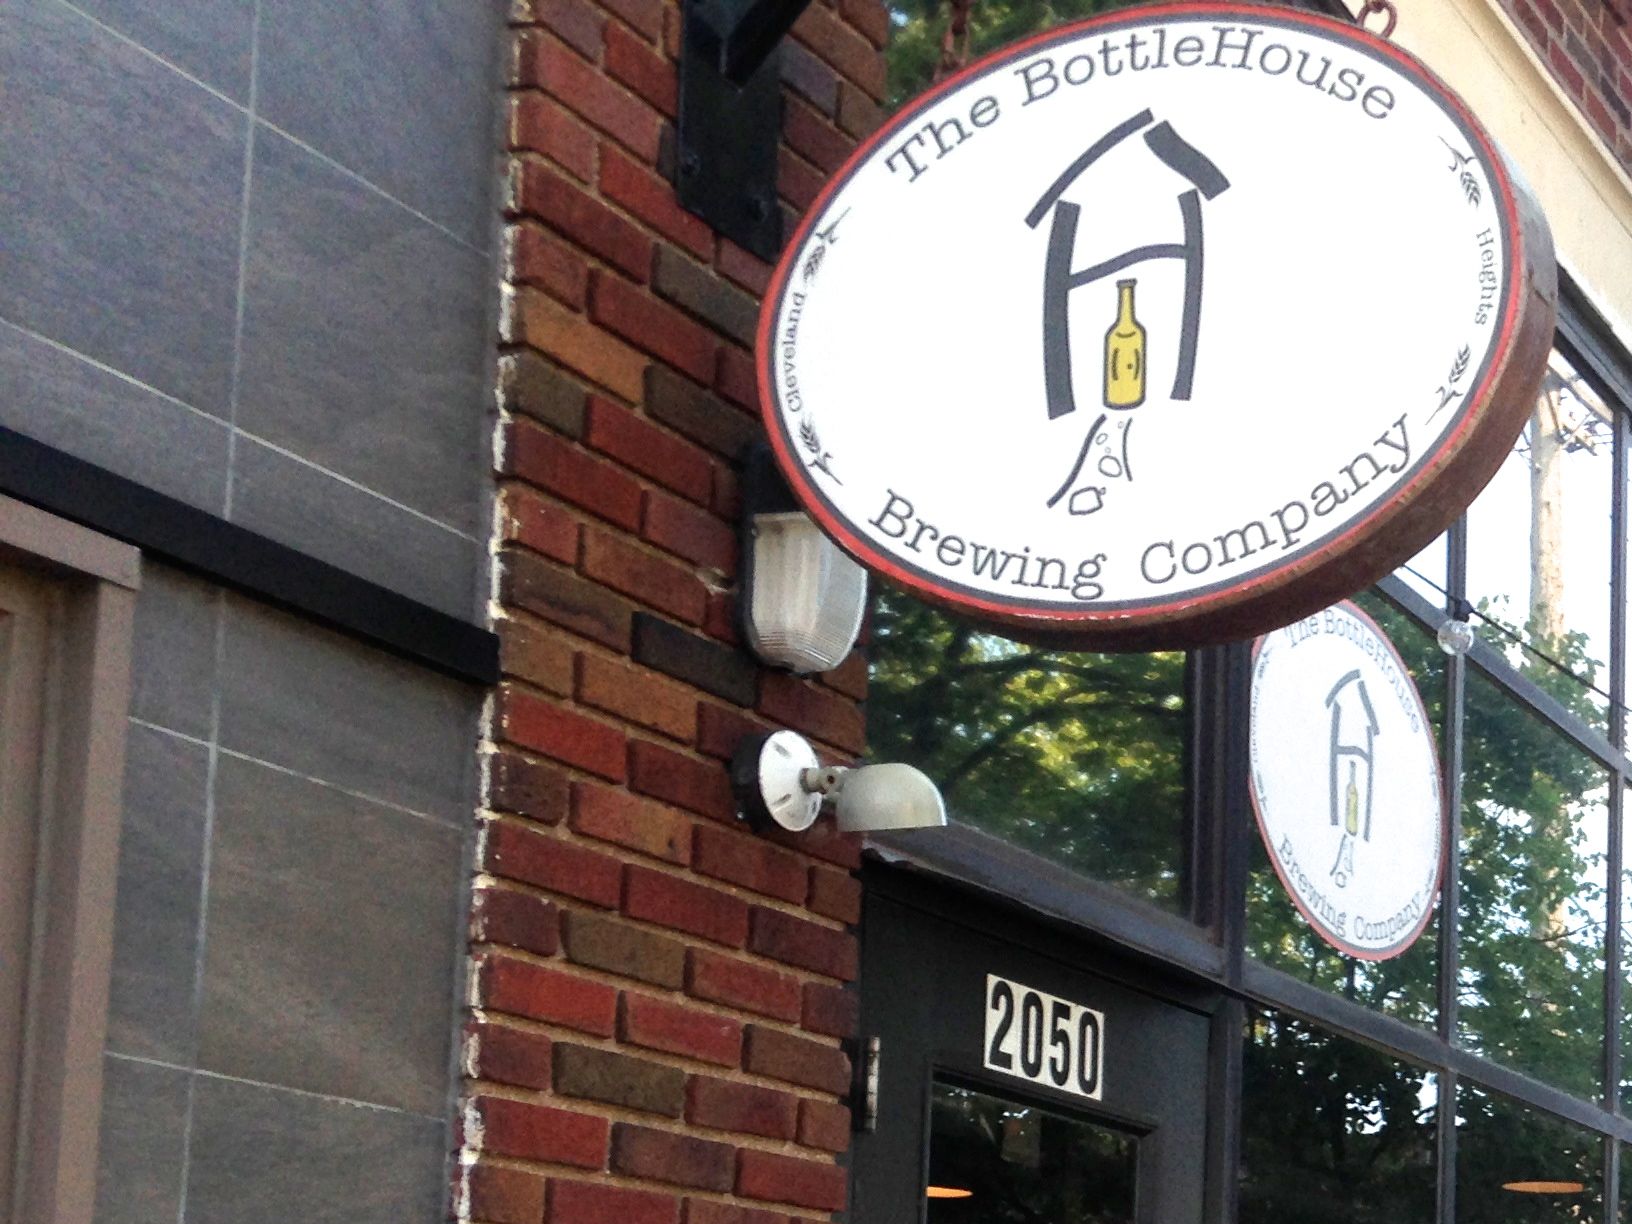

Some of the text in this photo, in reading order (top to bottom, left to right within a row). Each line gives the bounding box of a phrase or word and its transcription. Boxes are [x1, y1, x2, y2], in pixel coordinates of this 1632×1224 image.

[885, 26, 1397, 183] The BottleHouse
[1473, 225, 1501, 327] Heights
[787, 290, 808, 414] Cleveland
[866, 413, 1417, 601] Brewing Company
[1283, 615, 1320, 649] The
[1279, 832, 1347, 938] Brewing
[1353, 891, 1422, 942] Company
[988, 979, 1100, 1095] 2050
